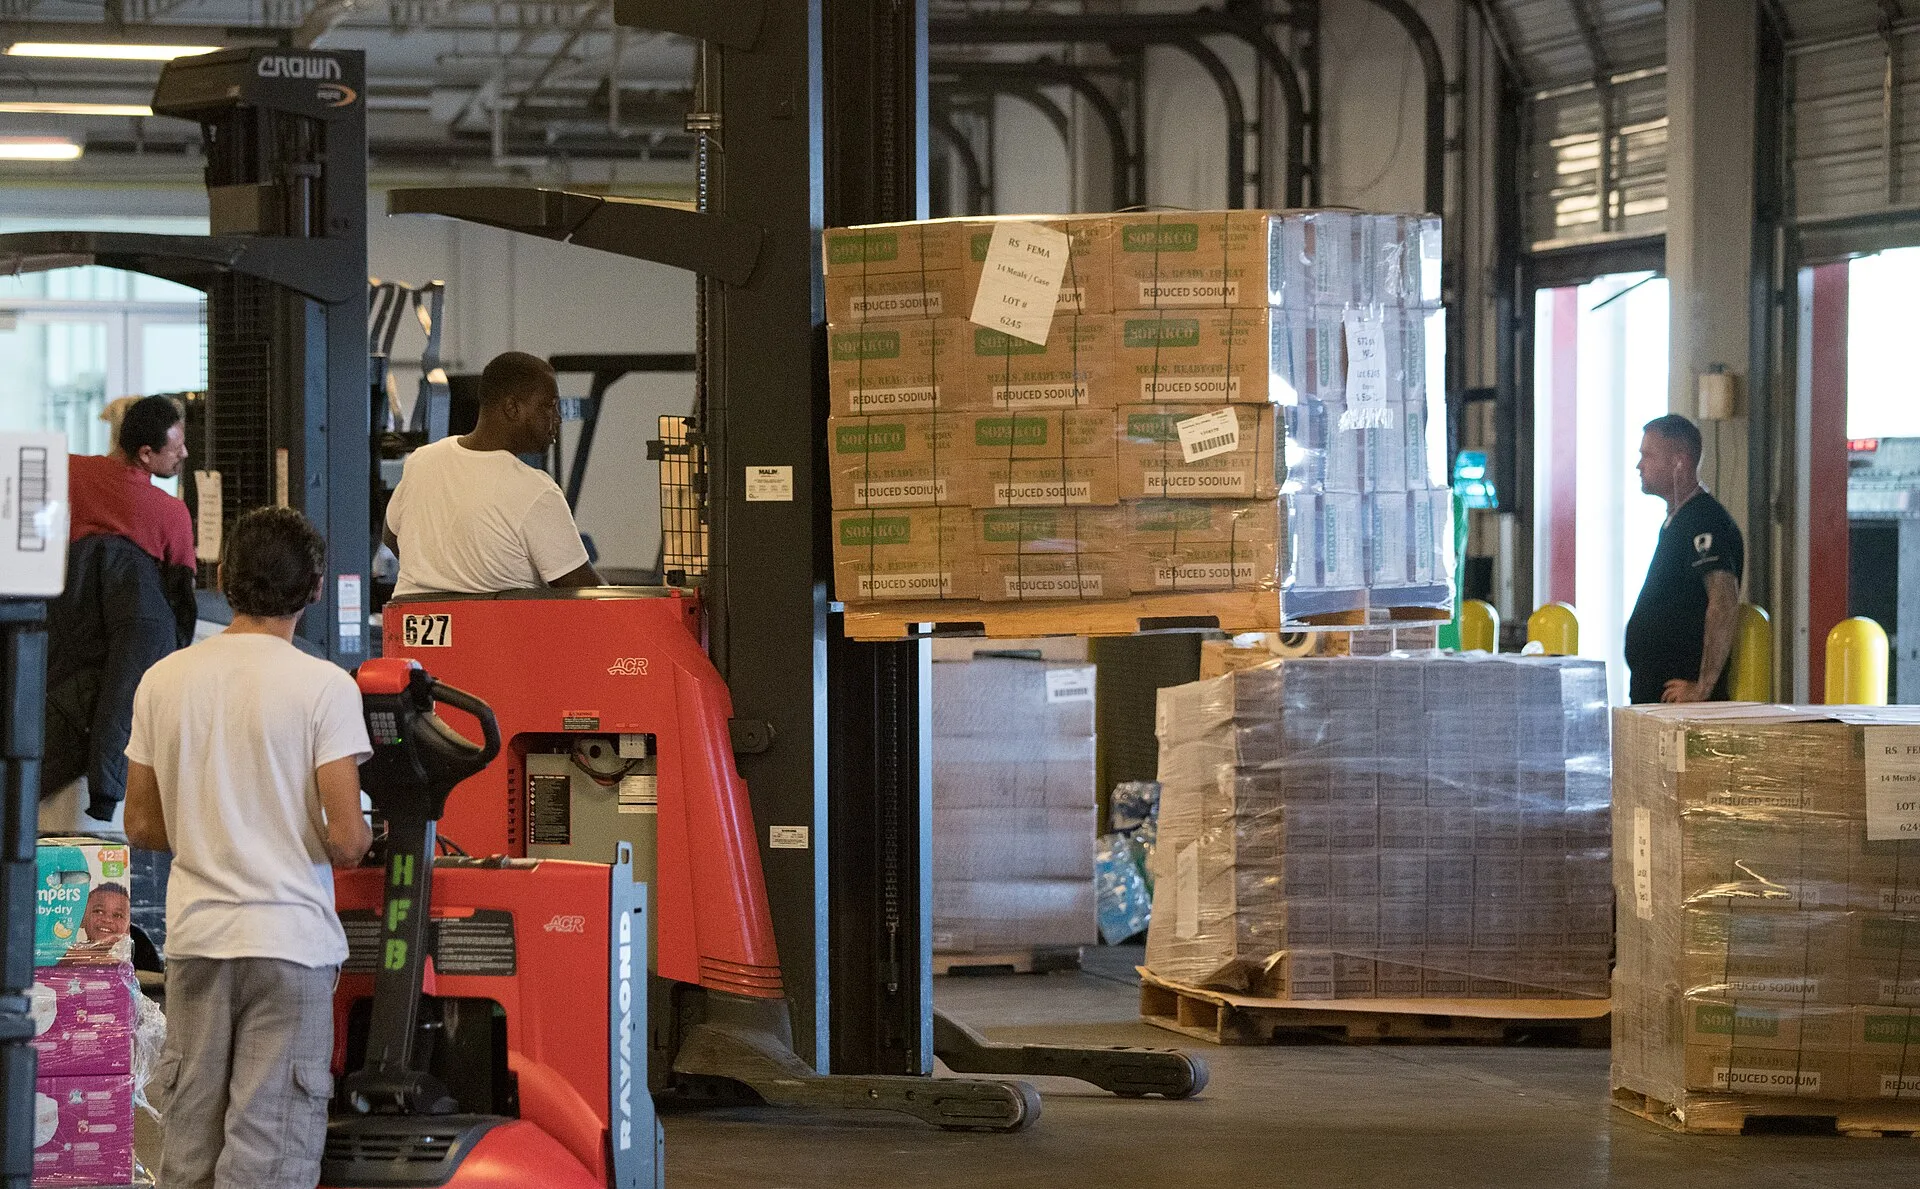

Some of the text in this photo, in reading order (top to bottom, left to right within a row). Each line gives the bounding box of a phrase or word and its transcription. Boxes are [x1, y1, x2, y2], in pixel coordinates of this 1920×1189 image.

[258, 56, 341, 79] CROWN
[1128, 231, 1192, 244] SOPAKCO
[1008, 238, 1050, 258] RS FEMA
[996, 264, 1005, 272] 14
[1007, 267, 1027, 280] Meals
[1034, 276, 1050, 286] Case
[1143, 286, 1235, 297] REDUCED SODIUM
[854, 297, 939, 311] REDUCED SODIUM
[1002, 295, 1020, 306] LOT
[1000, 316, 1021, 329] 6245
[1130, 327, 1193, 340] SOPAKCO
[837, 339, 895, 353] SOPAKCO
[1194, 382, 1237, 392] SODIUM
[853, 394, 896, 405] REDUCED
[996, 388, 1085, 400] REDUCED SODIUM
[981, 425, 1041, 438] SOPAKCO
[841, 432, 900, 446] SOPAKCO
[1148, 476, 1241, 487] REDUCED SODIUM
[858, 485, 944, 498] REDUCED SODIUM
[998, 487, 1087, 498] REDUCED SODIUM
[845, 525, 905, 538] SOPAKCO
[1159, 568, 1252, 579] REDUCED SODUM
[862, 578, 948, 590] REDUCED SODIUM
[1009, 580, 1099, 591] REDUCED SODUM
[405, 614, 449, 646] 627
[607, 658, 649, 676] ACR
[1885, 746, 1898, 755] RS
[1881, 774, 1916, 782] 14 Meals
[1896, 802, 1917, 811] LOT
[103, 851, 115, 861] 12
[543, 915, 586, 934] ACR
[1716, 981, 1815, 994] DUCED SODIUM
[1701, 1013, 1772, 1030] SOPAKCO
[619, 911, 632, 1151] RAYMOND
[1717, 1072, 1817, 1086] REDUCED SODUM
[1884, 1080, 1920, 1092] REDUC
